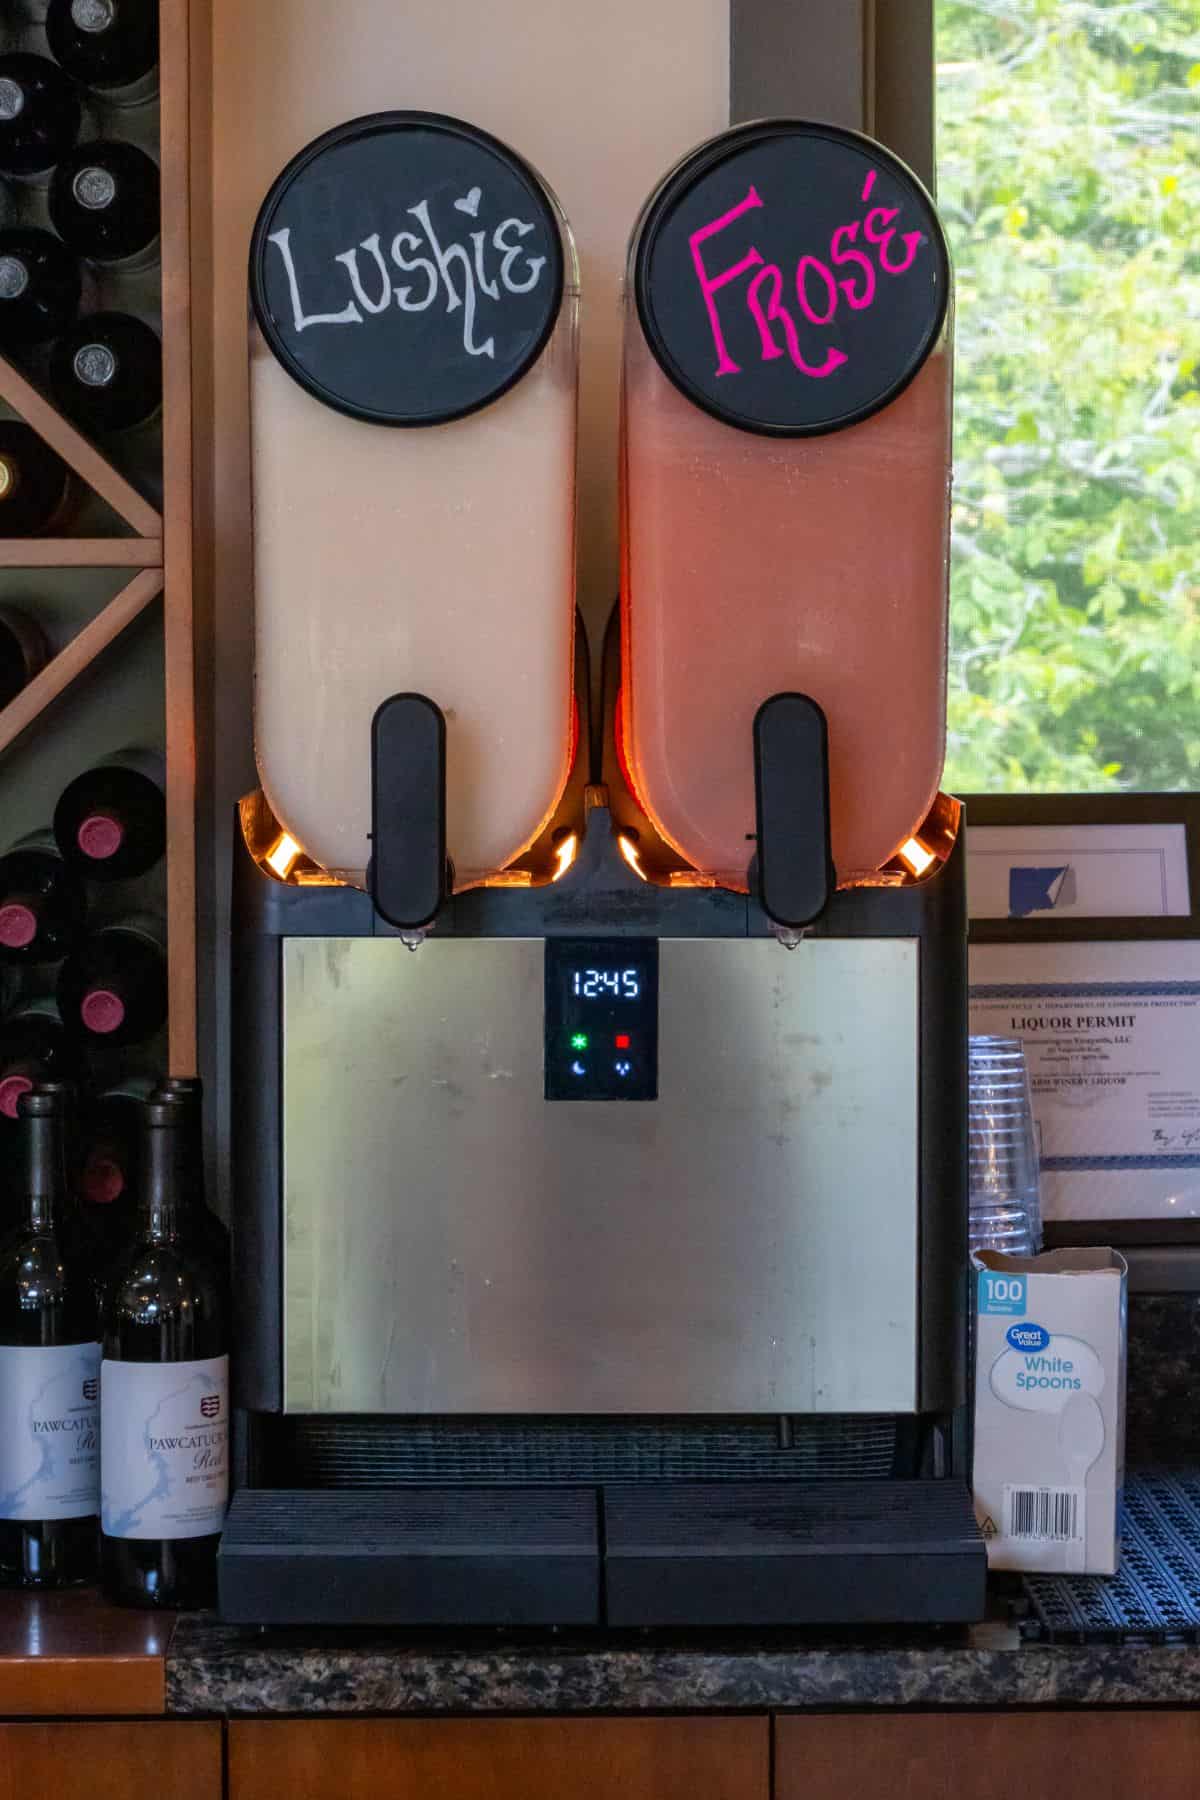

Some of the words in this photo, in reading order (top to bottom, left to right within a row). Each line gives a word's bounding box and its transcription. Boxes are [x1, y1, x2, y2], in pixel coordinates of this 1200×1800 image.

[574, 970, 639, 997] 12:45
[1011, 1016, 1072, 1031] LIQUOR
[1076, 1015, 1136, 1029] PERMIT
[986, 1279, 1023, 1301] 100
[1011, 1328, 1042, 1341] Great
[1024, 1357, 1073, 1373] White
[1016, 1372, 1081, 1391] Spoons
